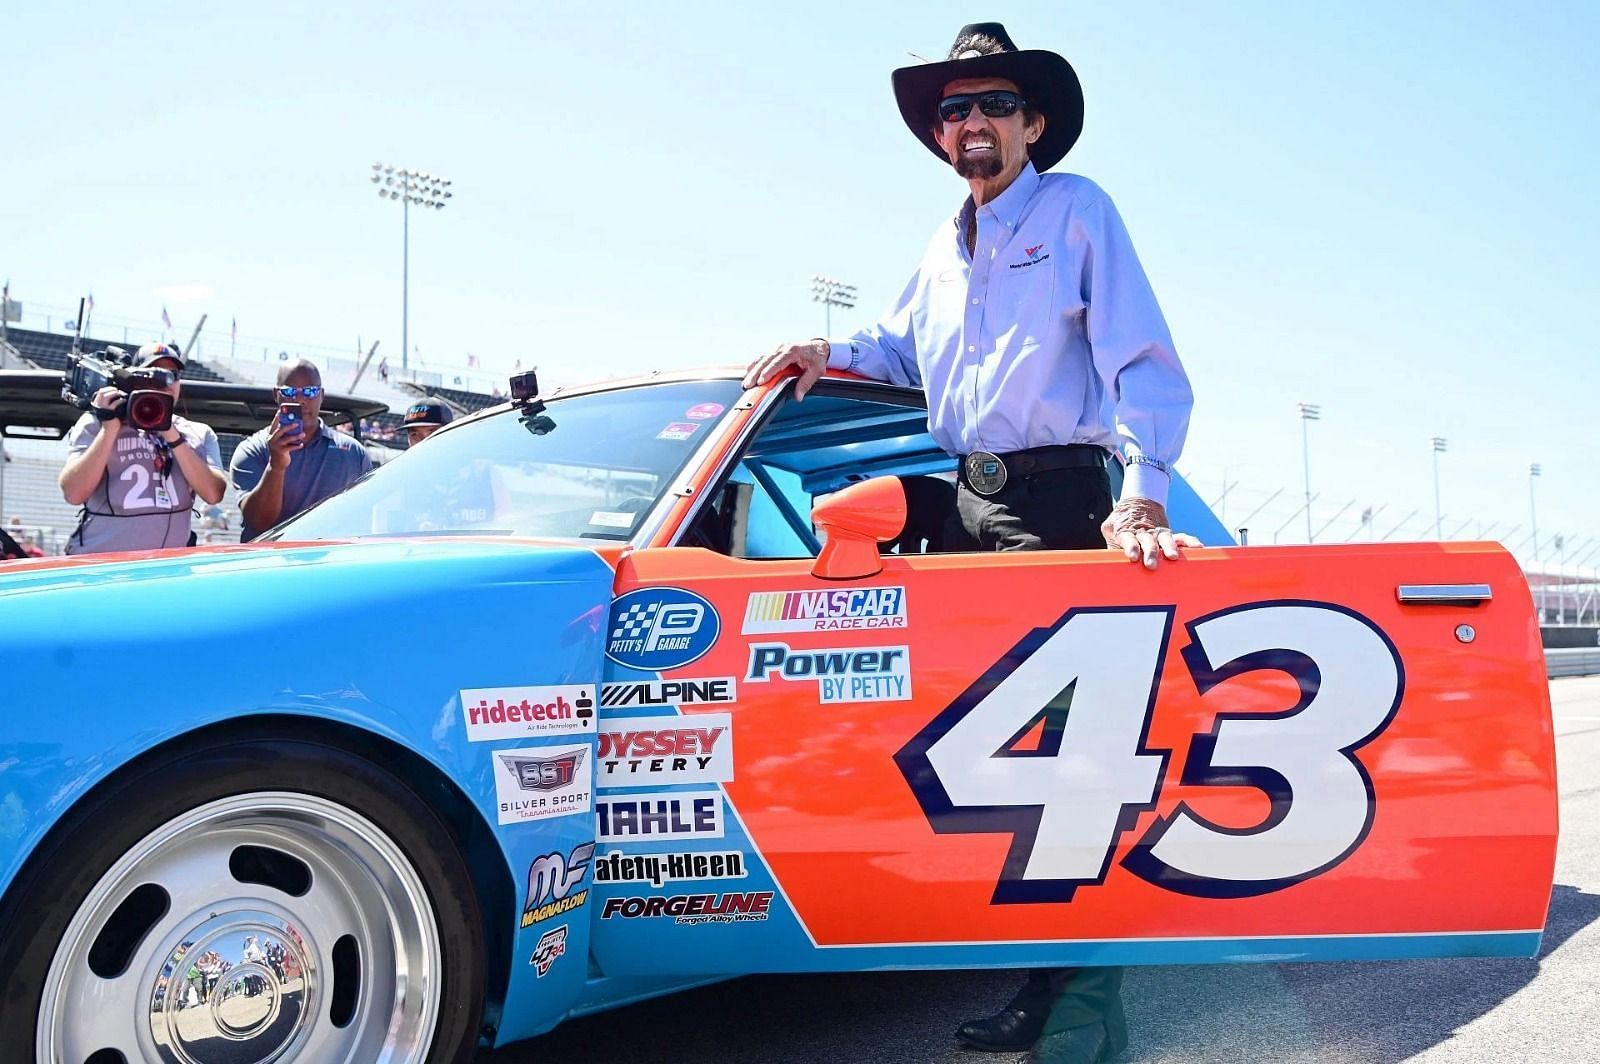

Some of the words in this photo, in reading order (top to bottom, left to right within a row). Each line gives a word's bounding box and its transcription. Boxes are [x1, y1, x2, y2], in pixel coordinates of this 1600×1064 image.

[797, 588, 899, 619] NASCAR
[814, 618, 864, 630] RACE
[866, 616, 904, 627] CAR
[609, 639, 643, 653] PETTY'S
[657, 636, 691, 651] GARAGE
[749, 645, 904, 679] Power
[823, 677, 847, 700] BY
[852, 675, 905, 699] PETTY
[469, 696, 571, 725] ridetech
[597, 727, 725, 759] DYSSEY
[892, 598, 1405, 905] 43
[604, 757, 712, 774] TTERY
[501, 798, 546, 812] SILVER
[552, 793, 589, 805] SPORT
[594, 853, 742, 885] afety-kleen
[521, 889, 588, 928] MAGNAFLOW
[601, 892, 773, 918] FORGELINE
[675, 915, 708, 925] Forged
[709, 914, 734, 924] Alloy
[734, 912, 767, 922] Wheels
